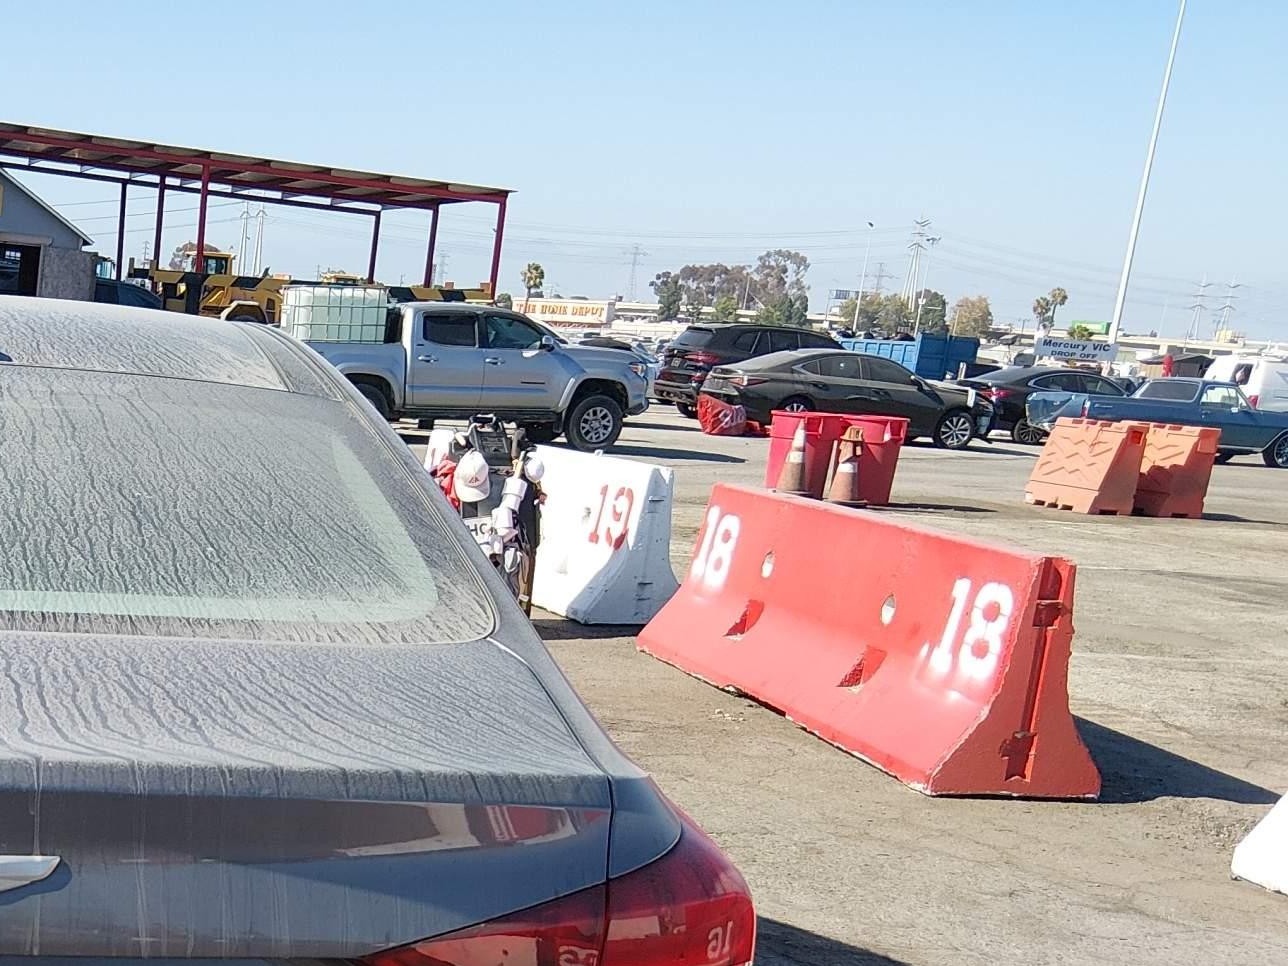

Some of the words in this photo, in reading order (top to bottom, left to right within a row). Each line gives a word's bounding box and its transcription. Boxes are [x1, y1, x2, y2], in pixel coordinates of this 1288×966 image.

[572, 304, 604, 316] DEPOT
[1043, 339, 1087, 351] Mercury
[1092, 343, 1110, 352] VIC
[1051, 350, 1076, 358] DROP
[588, 484, 634, 550] 19
[692, 505, 740, 588] 18
[929, 577, 1012, 680] 18
